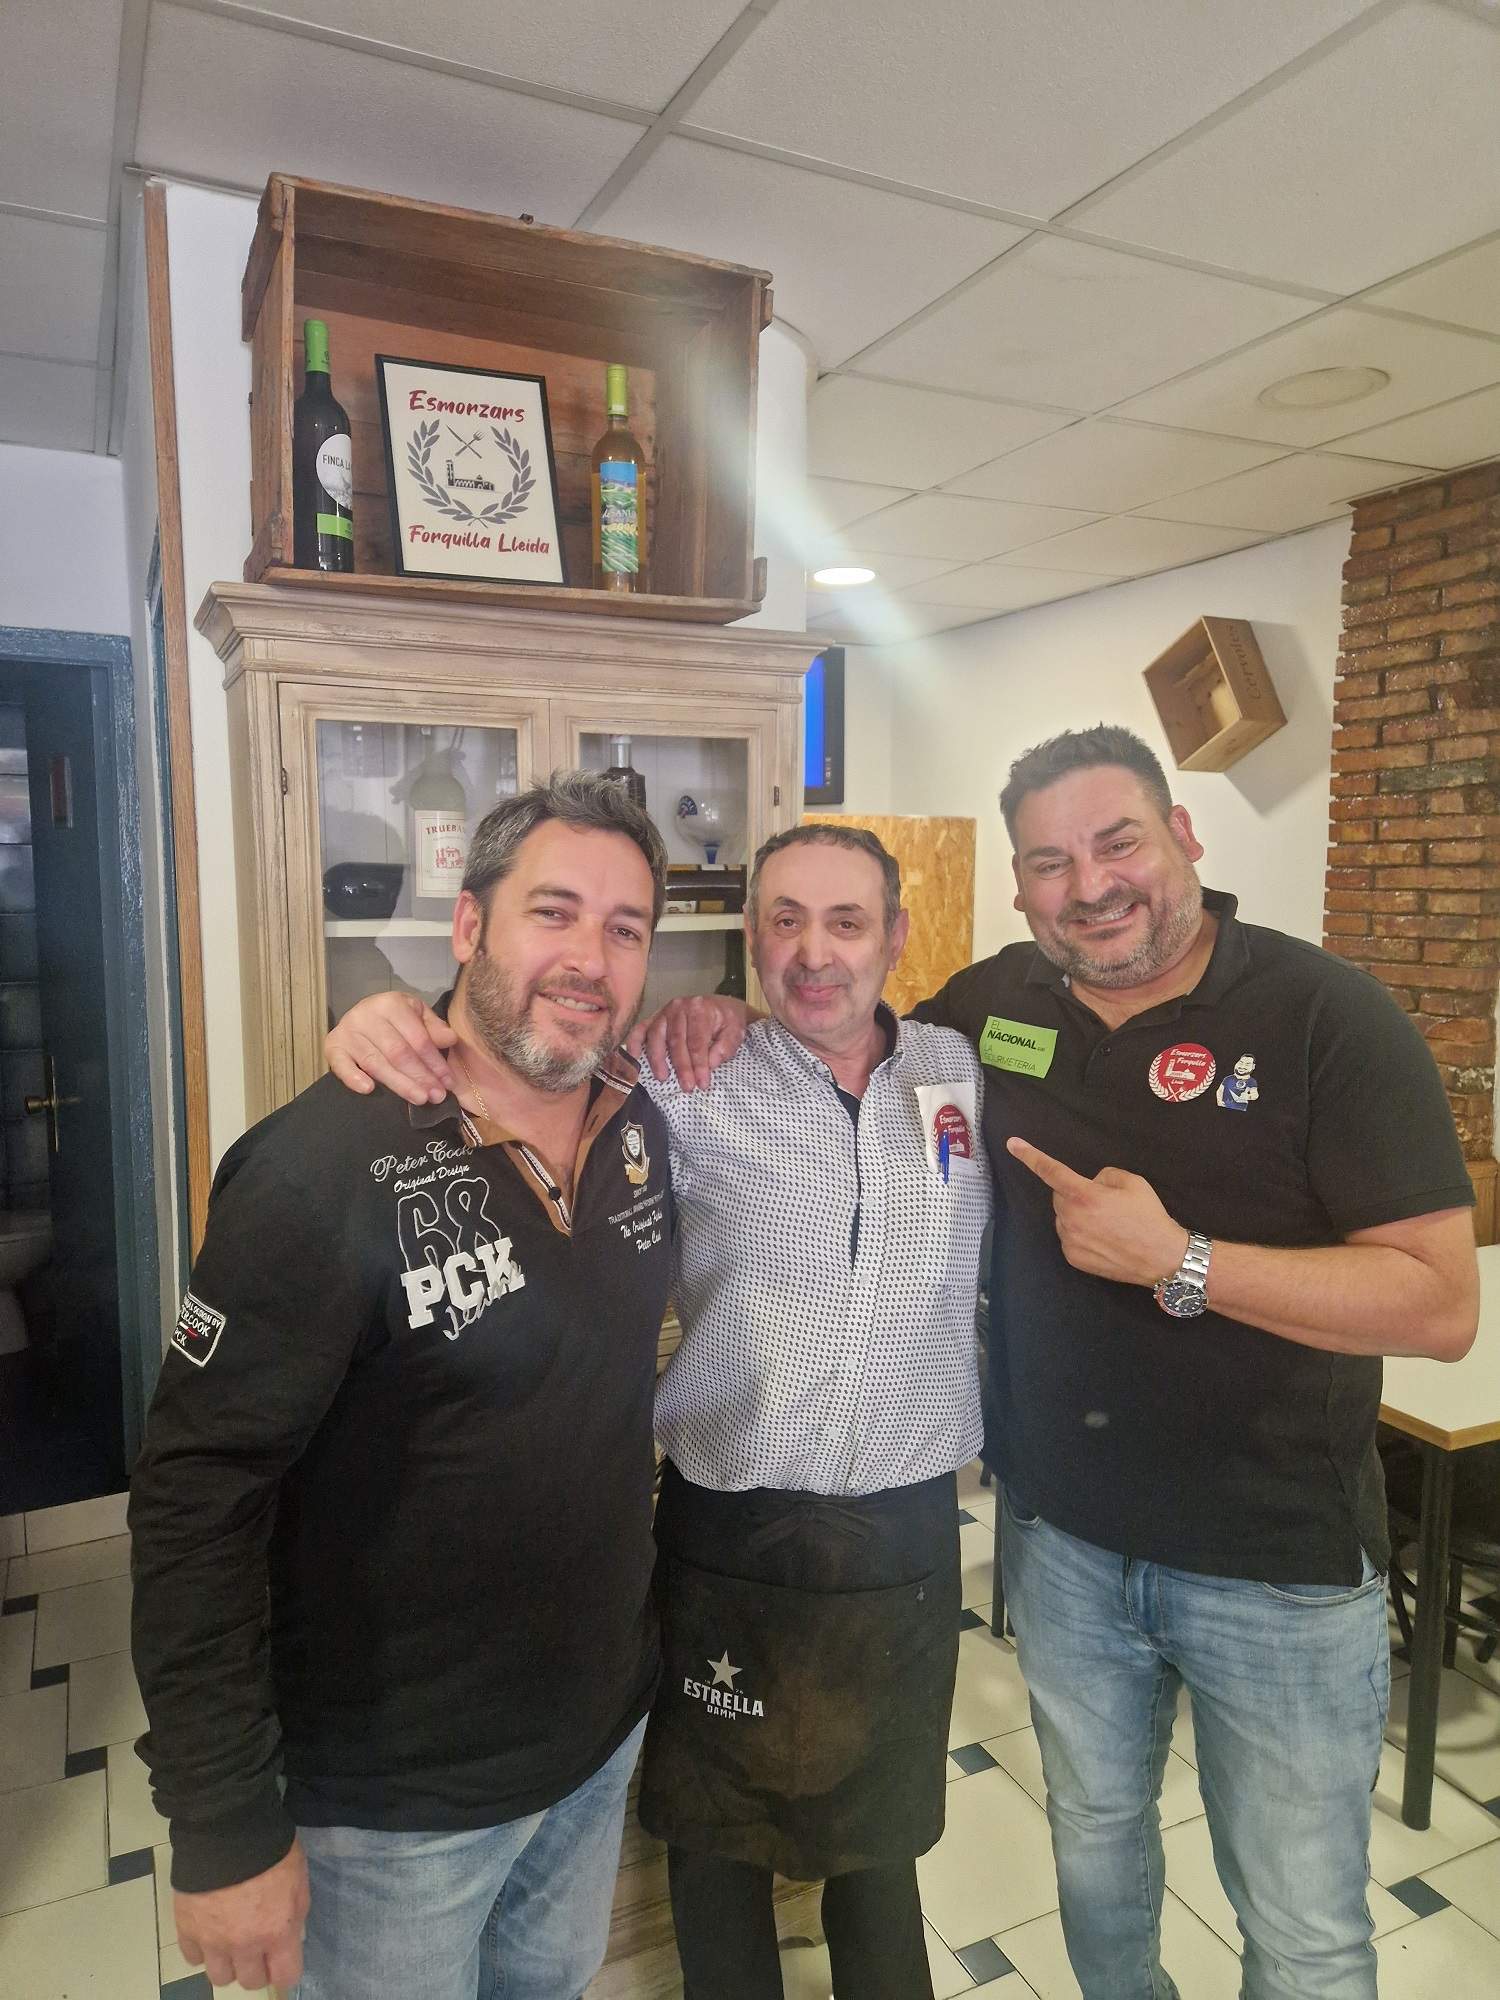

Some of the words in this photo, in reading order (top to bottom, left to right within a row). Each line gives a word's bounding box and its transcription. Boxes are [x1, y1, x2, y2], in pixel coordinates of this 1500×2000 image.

[408, 389, 526, 423] Esmorzars
[322, 454, 345, 469] FINCA
[408, 524, 491, 550] Forquilla
[498, 532, 550, 554] Lleida
[986, 1029, 1037, 1050] NACIONAL
[990, 1019, 1001, 1031] EL
[370, 1154, 429, 1183] Peter
[394, 1171, 437, 1193] Original
[436, 1163, 470, 1180] Design
[400, 1236, 526, 1330] PCK
[211, 1317, 221, 1329] BY
[683, 1676, 765, 1717] ESTRELLA
[706, 1704, 737, 1721] DAMM
